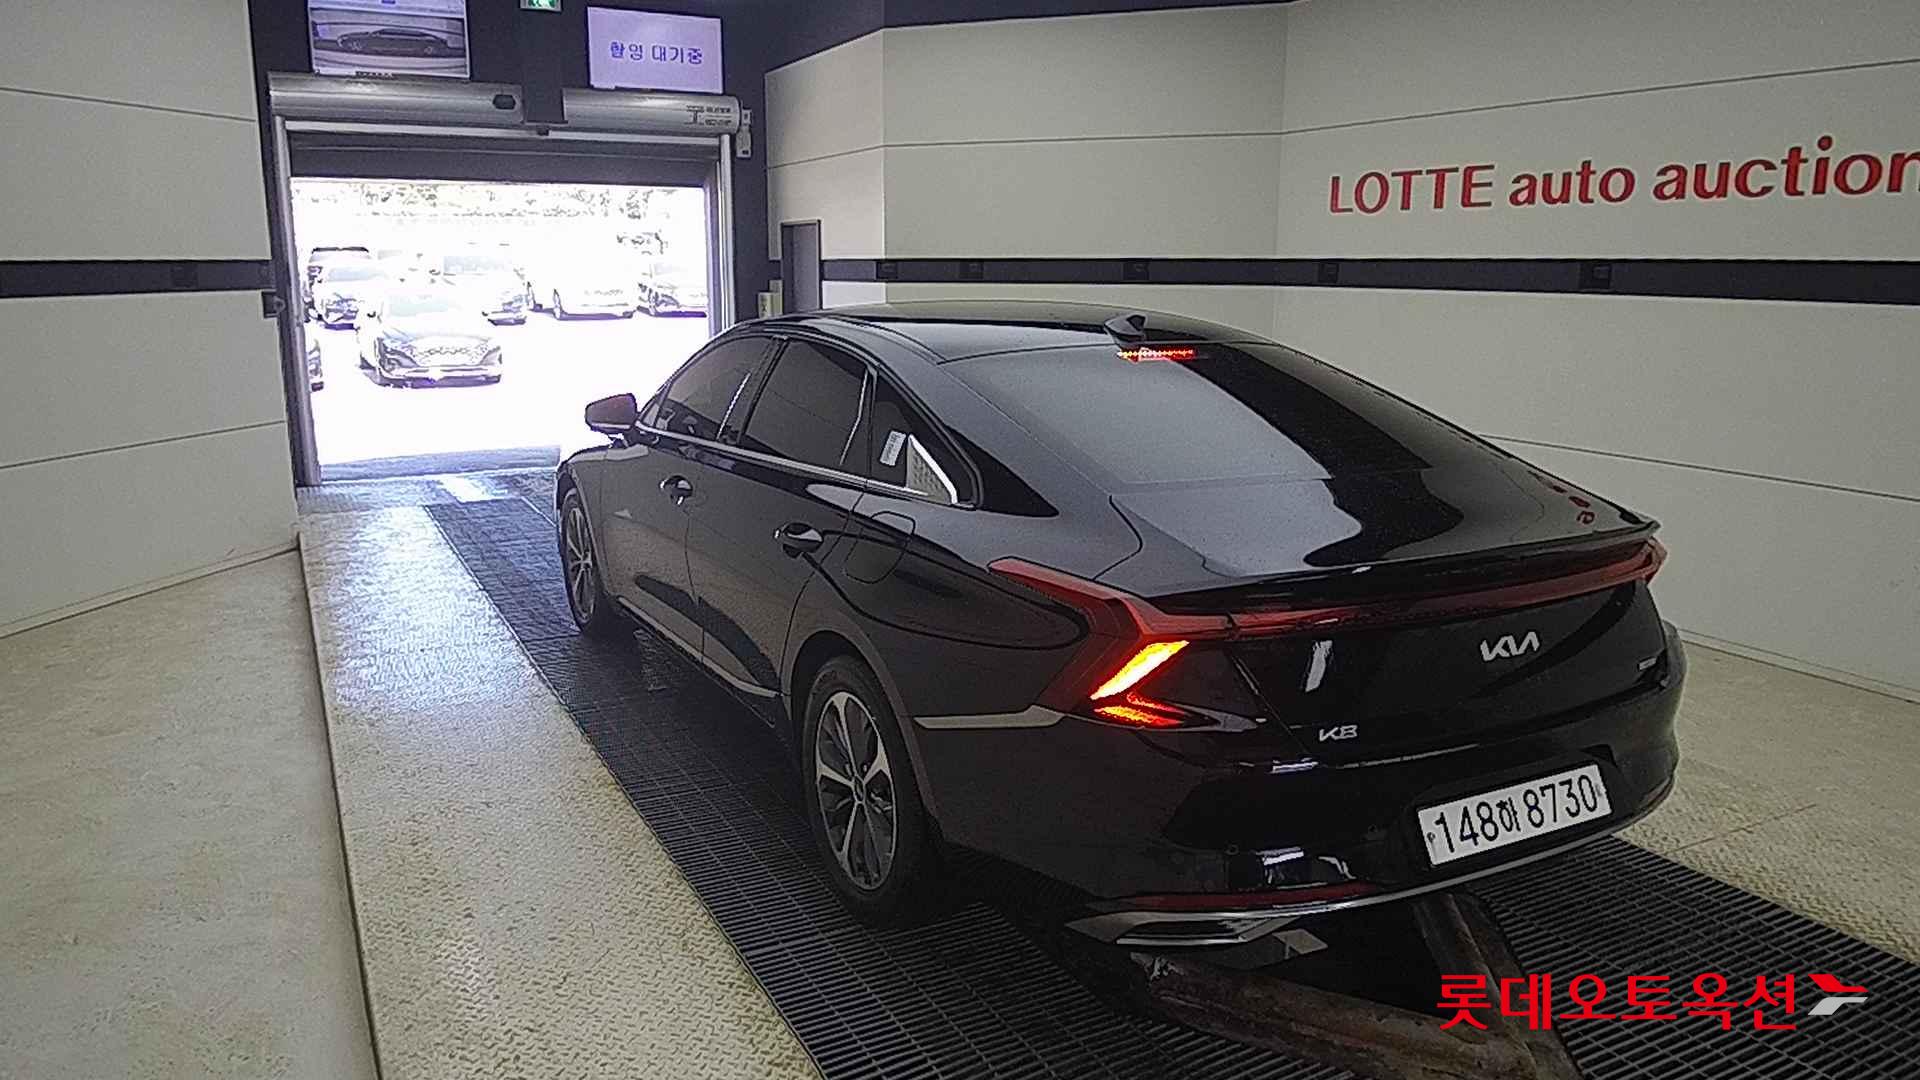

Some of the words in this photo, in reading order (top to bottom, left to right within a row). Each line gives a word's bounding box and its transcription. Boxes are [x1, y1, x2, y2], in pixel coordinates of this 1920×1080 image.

[651, 44, 703, 65] 대기중
[1330, 164, 1496, 214] LOTTE
[1509, 160, 1637, 207] auto
[1480, 631, 1540, 662] KIA
[1318, 724, 1359, 742] K8
[1434, 797, 1521, 853] 148하
[1523, 774, 1598, 828] 8730
